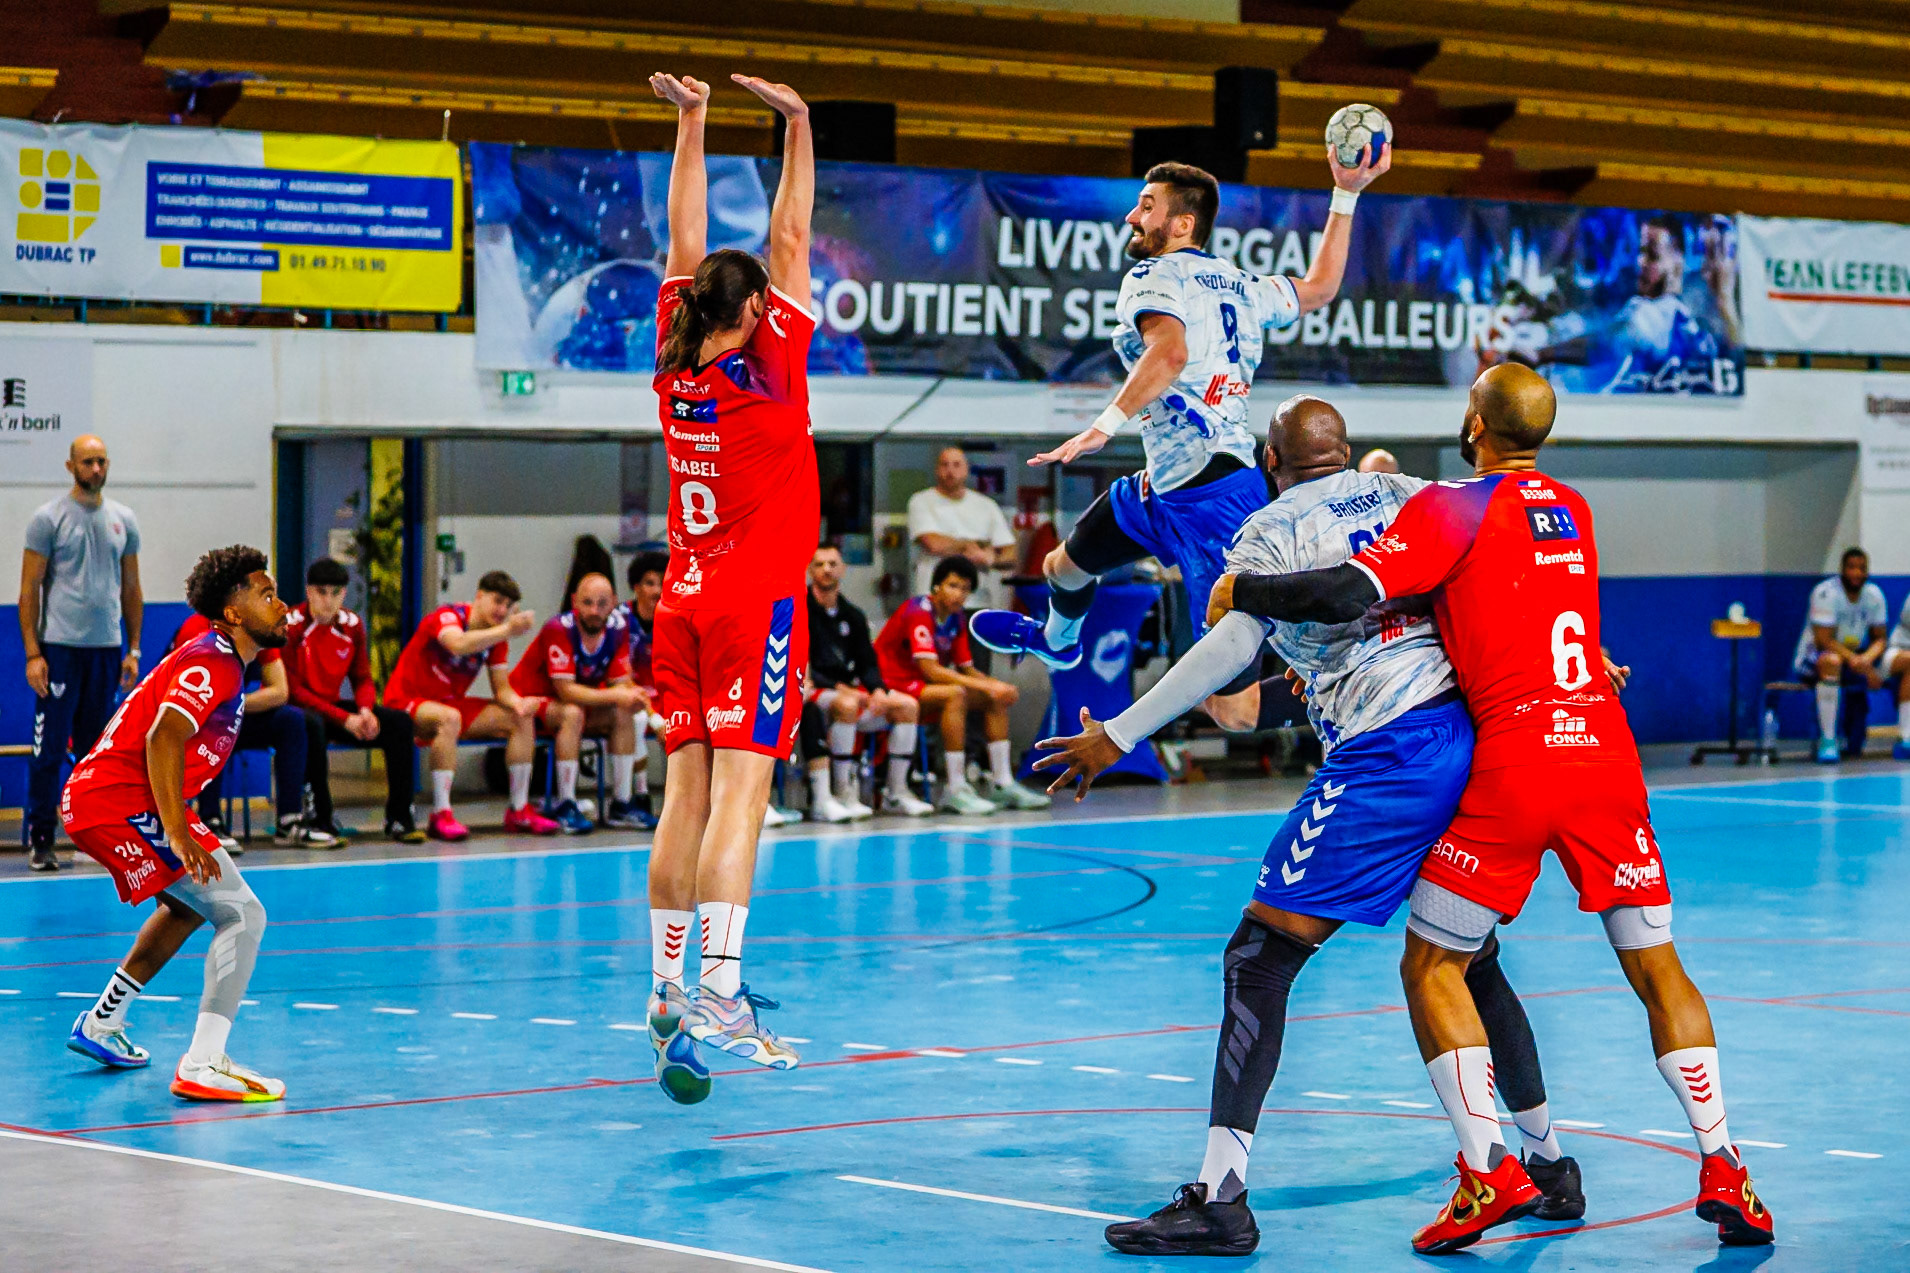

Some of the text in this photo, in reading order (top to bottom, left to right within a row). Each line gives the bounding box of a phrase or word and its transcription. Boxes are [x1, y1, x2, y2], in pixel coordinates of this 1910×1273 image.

[16, 244, 96, 263] DUBRAC TP
[811, 276, 1051, 338] SOUTIENT
[1062, 289, 1118, 340] SE
[22, 413, 61, 431] baril
[669, 425, 720, 443] Rematch
[696, 444, 719, 452] SPORT
[1520, 489, 1557, 500] B33HB
[680, 481, 720, 535] 8
[1534, 548, 1584, 565] Rematch
[1550, 610, 1593, 691] 6
[727, 676, 744, 701] 8
[1543, 734, 1600, 746] FONCIA
[1635, 827, 1650, 855] 6
[114, 841, 144, 863] 24
